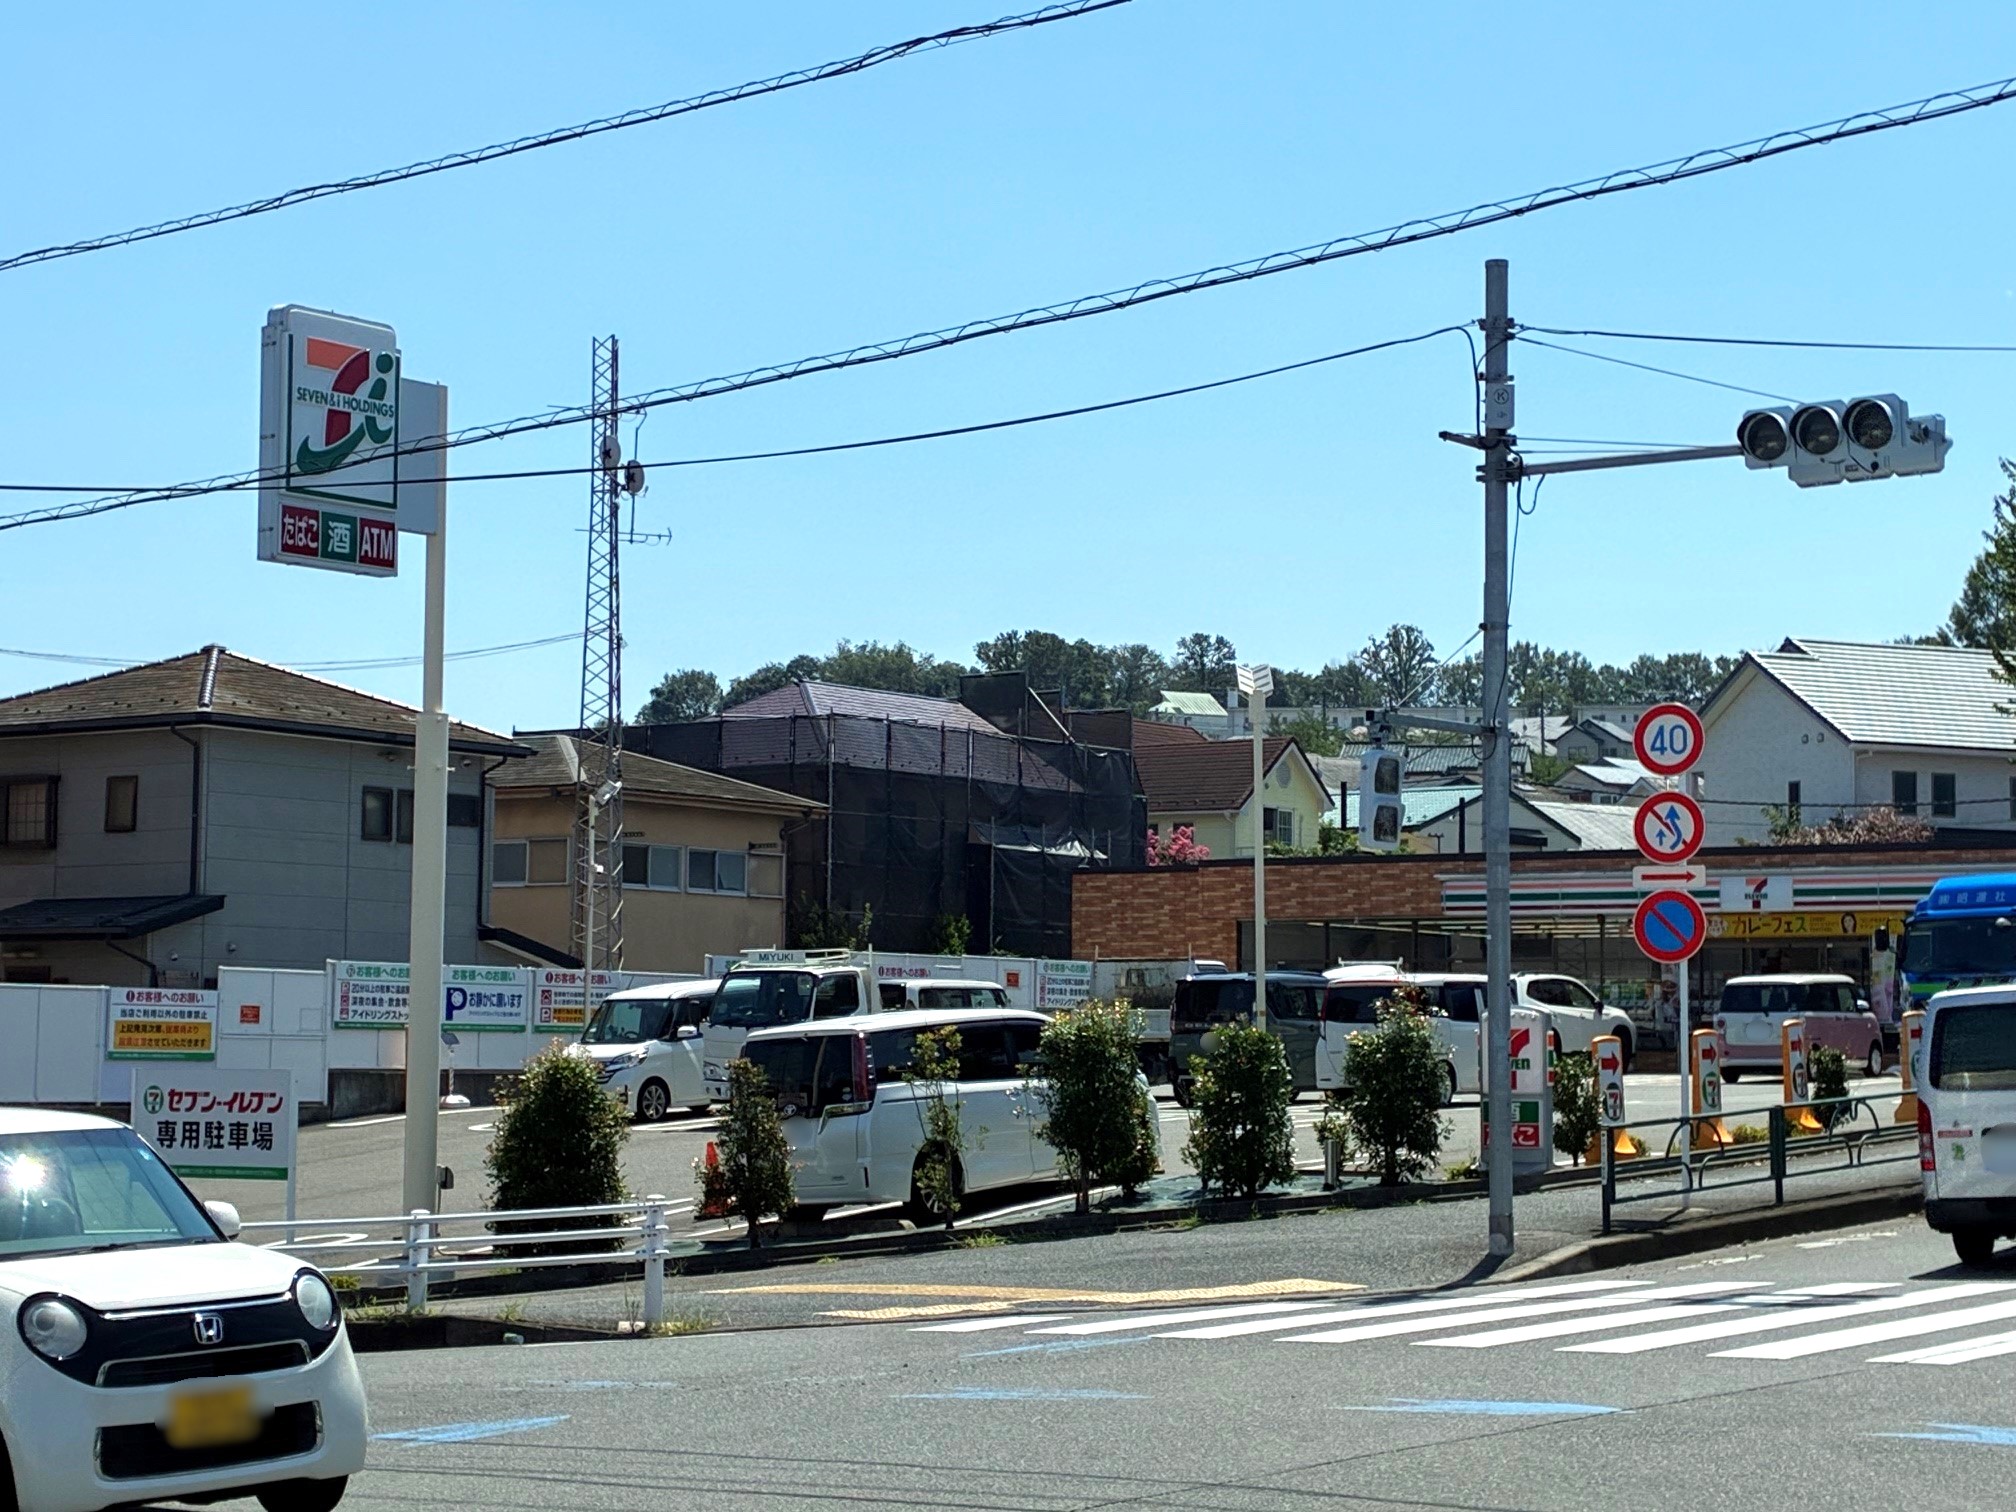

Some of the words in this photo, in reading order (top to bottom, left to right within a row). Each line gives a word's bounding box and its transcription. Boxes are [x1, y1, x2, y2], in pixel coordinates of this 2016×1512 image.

[343, 397, 394, 418] HOLDINGS
[283, 513, 318, 548] たばこ
[328, 521, 351, 553] 酒
[361, 526, 394, 561] ATM
[1650, 724, 1688, 756] 40
[1732, 916, 1806, 934] カレーフェス
[452, 969, 516, 981] お客様へのお願い
[554, 972, 612, 985] お客様へお願い
[136, 991, 204, 1003] お客様へのお願い
[156, 1120, 274, 1151] 専用駐車場
